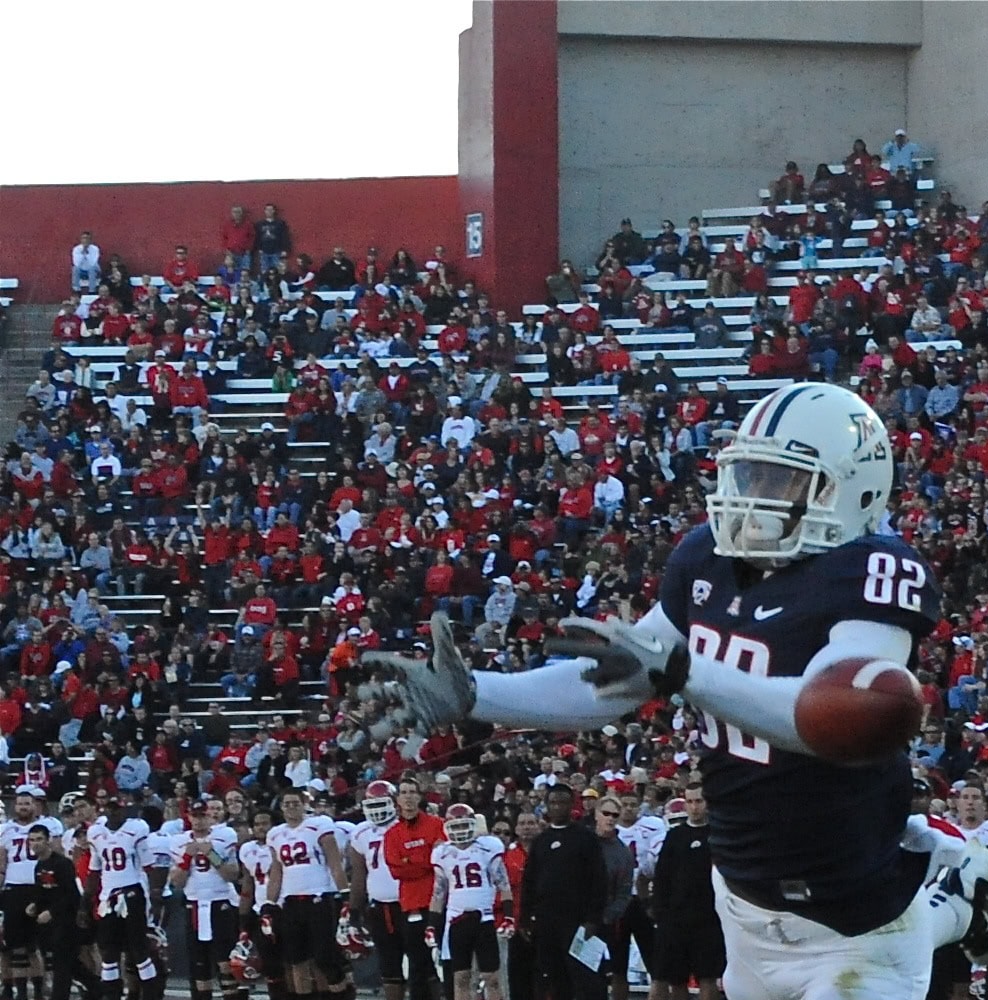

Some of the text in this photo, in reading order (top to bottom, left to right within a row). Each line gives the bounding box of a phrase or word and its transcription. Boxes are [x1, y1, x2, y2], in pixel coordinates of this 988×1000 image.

[863, 551, 927, 612] 82
[101, 847, 126, 871] 10
[195, 853, 211, 872] 9
[280, 841, 311, 867] 82
[452, 862, 482, 889] 16
